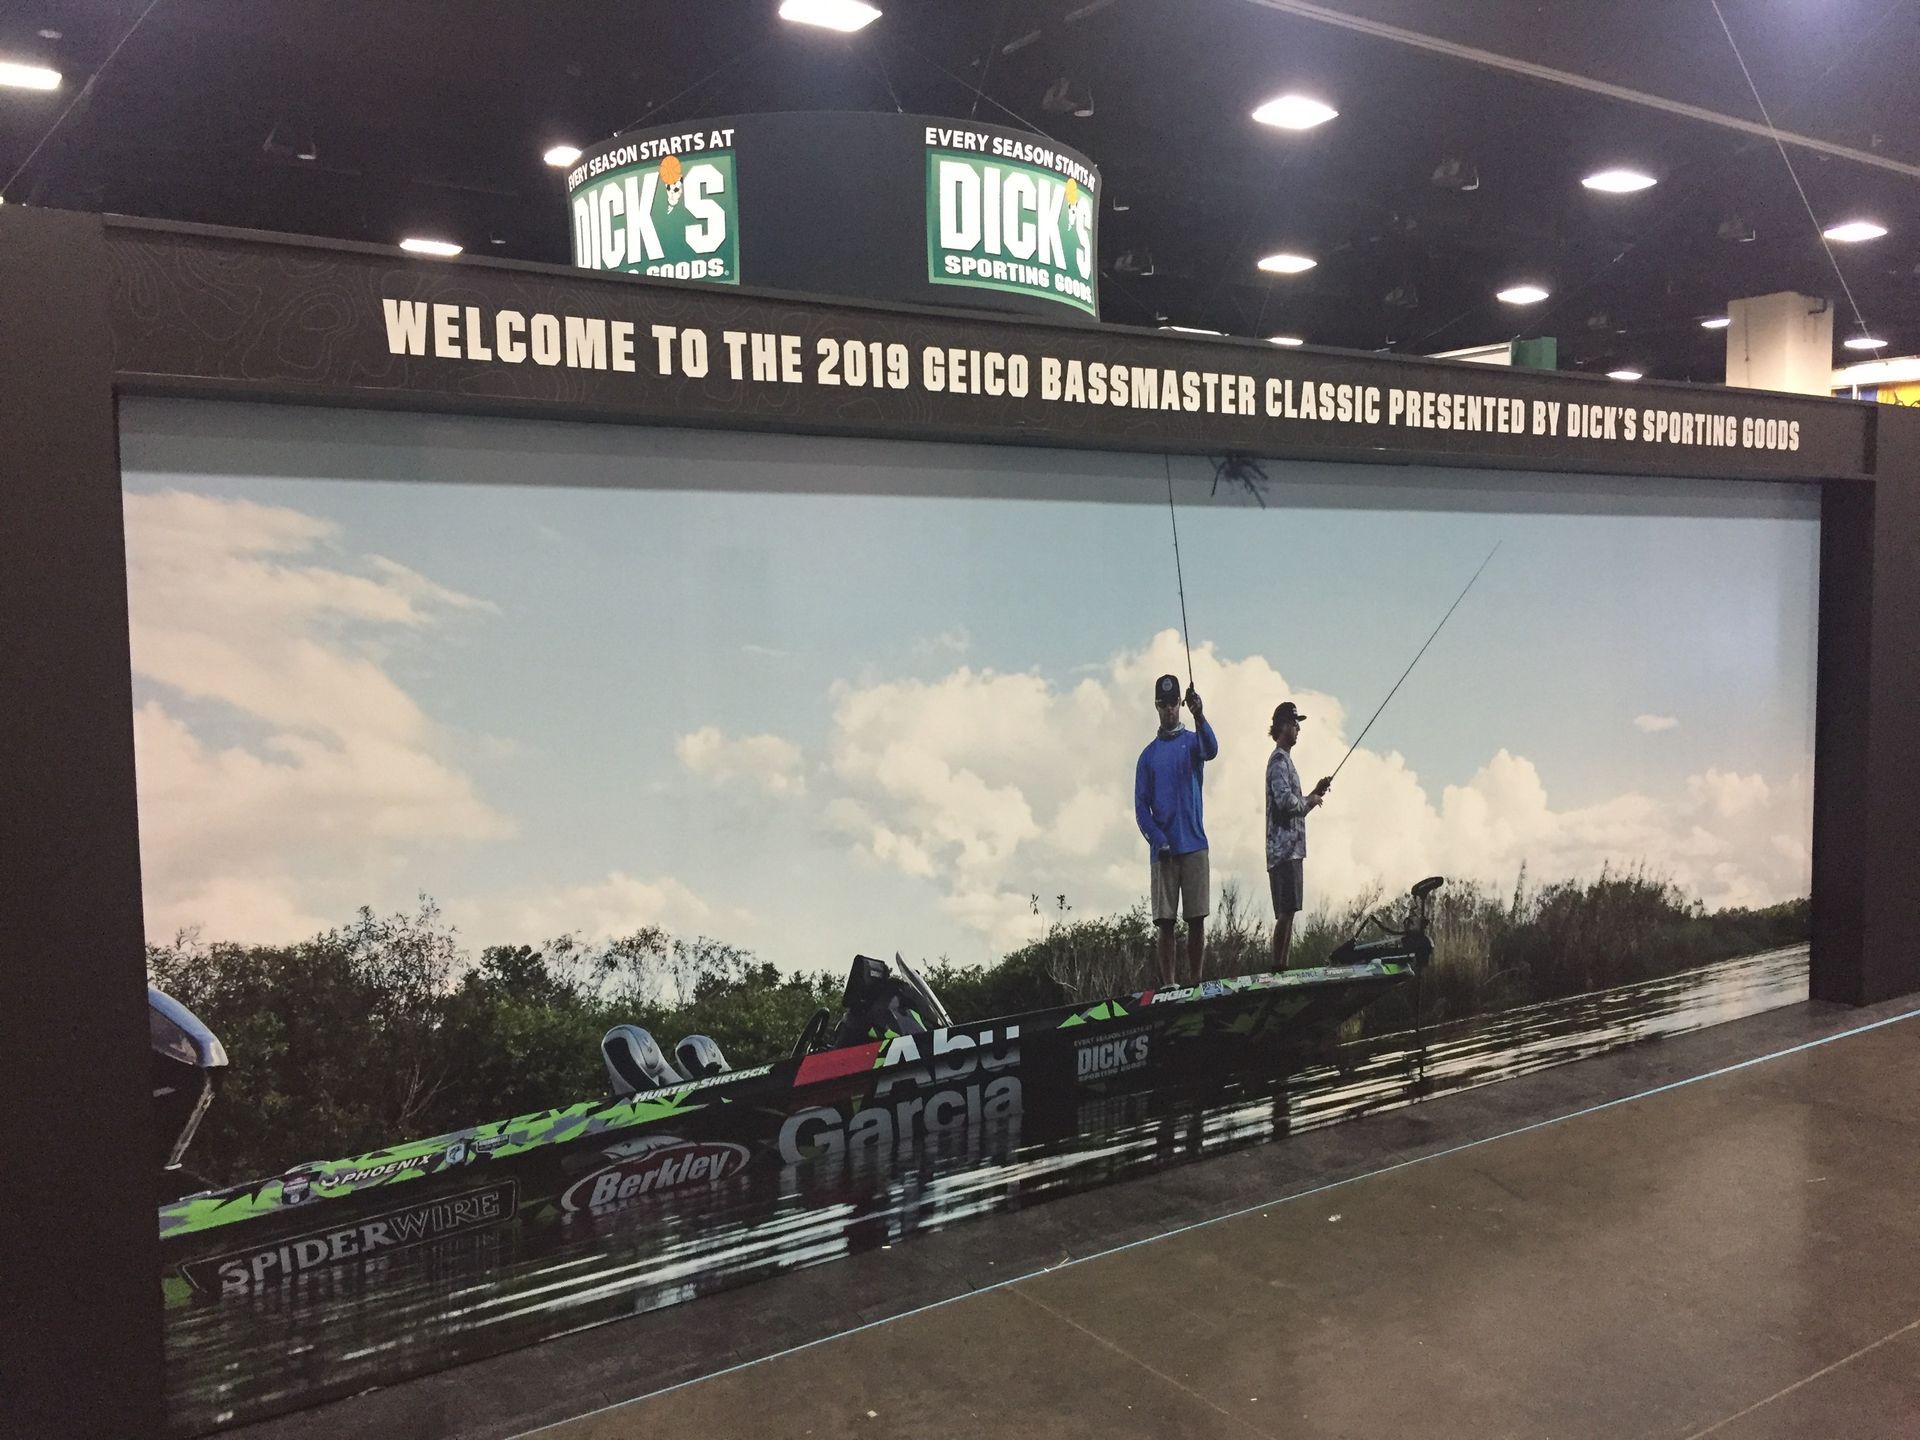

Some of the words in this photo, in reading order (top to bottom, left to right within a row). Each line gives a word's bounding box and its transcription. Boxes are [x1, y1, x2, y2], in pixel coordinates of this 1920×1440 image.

[568, 162, 588, 192] EVERY
[590, 144, 638, 177] SEASON
[640, 132, 705, 160] STARTS
[709, 128, 735, 149] AT
[925, 126, 989, 152] EVERY
[992, 136, 1054, 168] SEASON
[1055, 154, 1089, 184] STARTS
[944, 255, 1050, 288] SPORTING
[1054, 273, 1093, 304] GOODS
[382, 298, 636, 373] WELCOME
[651, 324, 709, 378] TO
[723, 330, 803, 384] THE
[816, 337, 910, 390] 2019
[922, 346, 1029, 399] GEICO
[1041, 356, 1256, 416] BASSMASTER
[1265, 377, 1381, 424] CLASSIC
[1388, 389, 1526, 435] PRESENTED
[1532, 400, 1562, 437] BY
[1566, 403, 1637, 442] DICK'S
[1642, 407, 1738, 448] SPORTING
[1742, 418, 1800, 452] GOODS
[875, 1025, 1021, 1099] Abu
[1077, 1034, 1149, 1075] DICK'S
[632, 1079, 698, 1104] HUNTER
[778, 1075, 1023, 1164] Garcia
[341, 1154, 433, 1185] PHOENIX
[588, 1150, 731, 1208] Berkley
[218, 1190, 500, 1292] SPIDERWIRE
